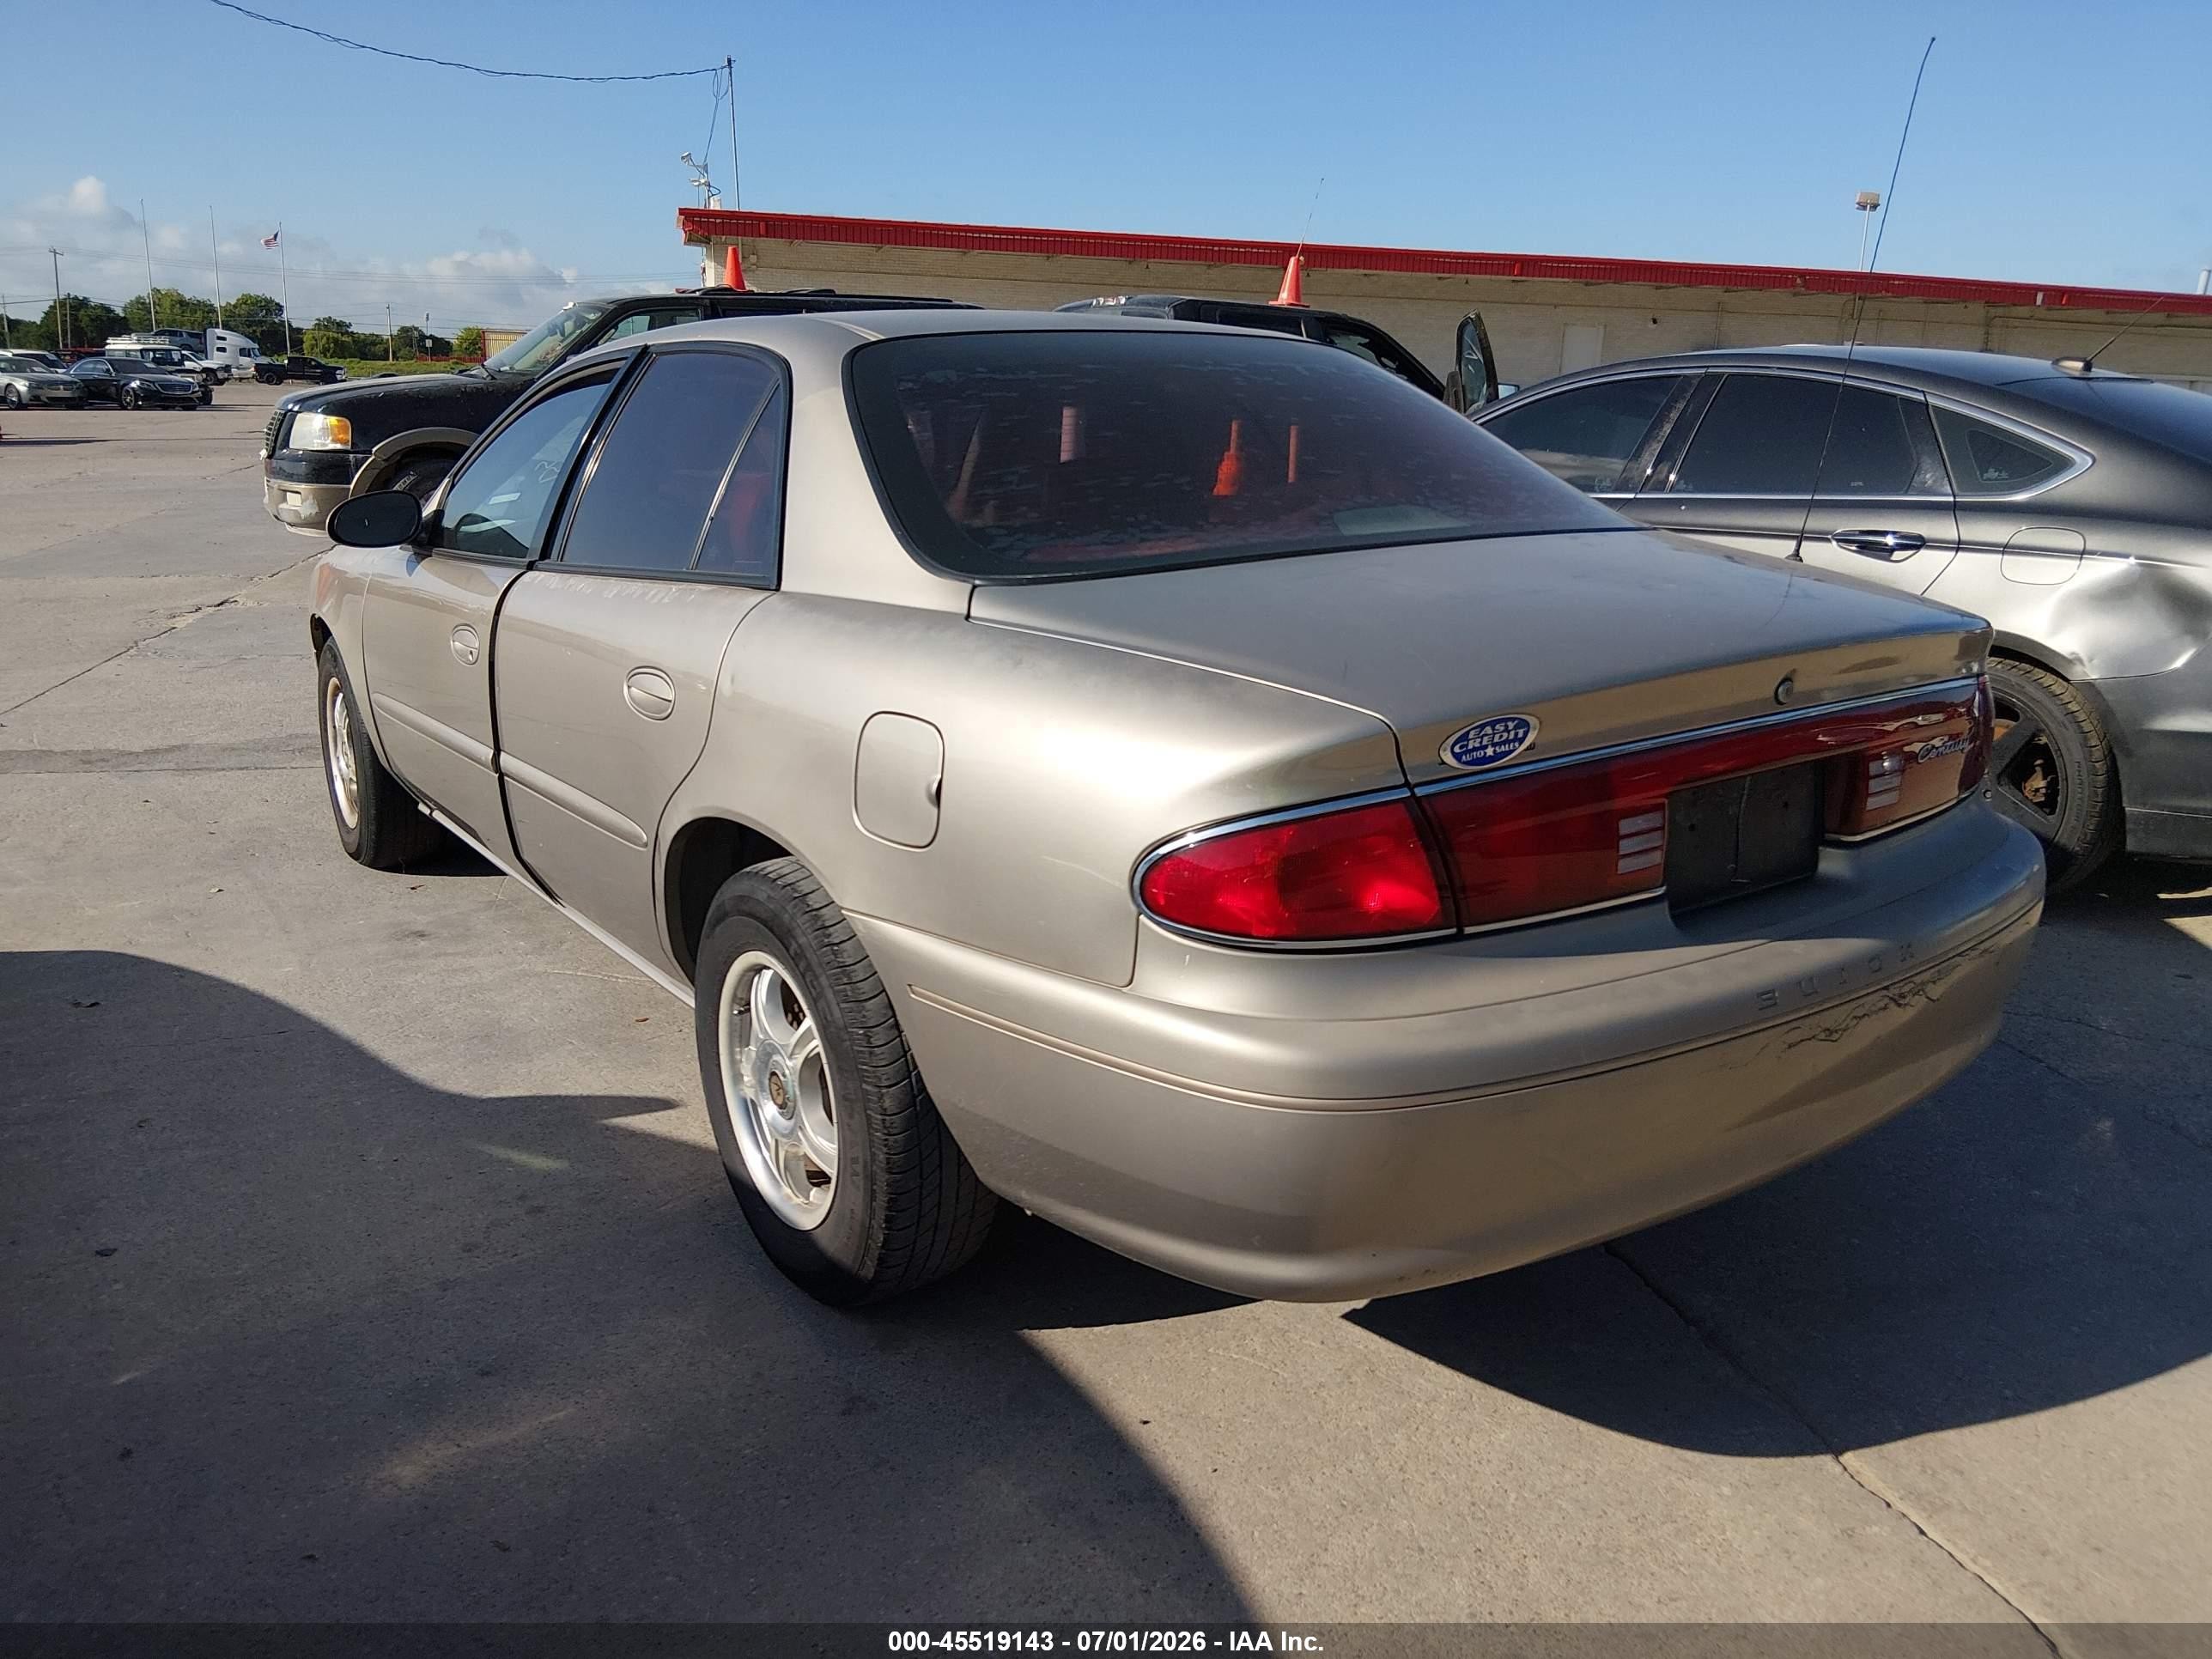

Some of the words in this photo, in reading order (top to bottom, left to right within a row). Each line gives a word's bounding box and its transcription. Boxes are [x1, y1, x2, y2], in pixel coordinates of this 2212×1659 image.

[1454, 728, 1526, 753] CREDIT
[1468, 720, 1519, 739] EASY
[1462, 750, 1484, 763] AUTO
[1495, 742, 1519, 754] SALES
[1917, 737, 1974, 763] Century
